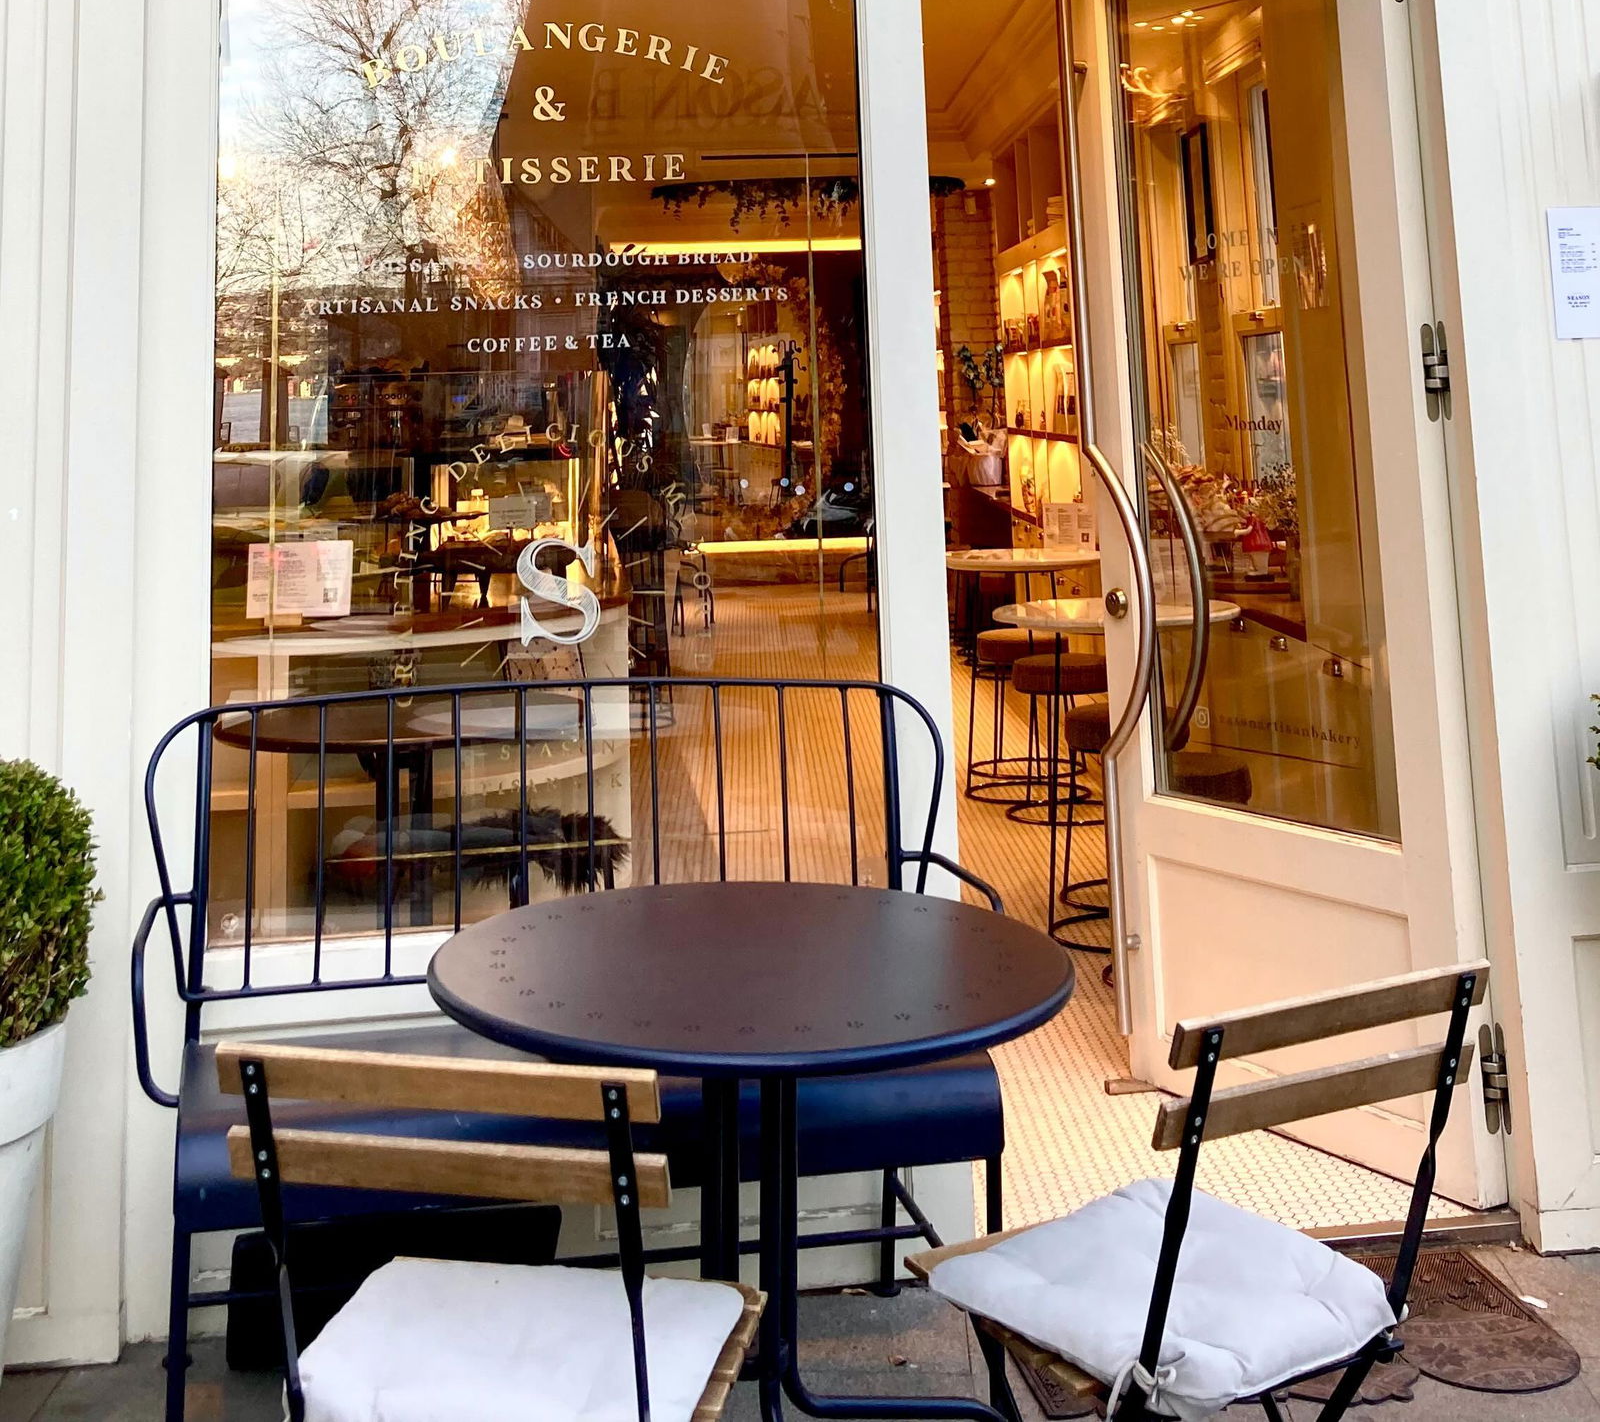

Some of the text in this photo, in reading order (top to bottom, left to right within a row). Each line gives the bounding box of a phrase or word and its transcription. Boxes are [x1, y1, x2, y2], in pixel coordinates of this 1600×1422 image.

[360, 22, 729, 90] BOULANGERIE
[532, 85, 566, 122] &
[523, 251, 669, 270] SOURDOUGH
[677, 251, 754, 266] BREAD
[1178, 256, 1307, 282] WE'RE OPEN
[301, 286, 789, 316] ARTISANAL SNACKS FRENCH DESSERTS
[467, 333, 631, 354] COFFEE & TEA
[1224, 414, 1283, 435] Monday
[448, 422, 654, 484] DELICIOUS
[516, 537, 602, 648] S
